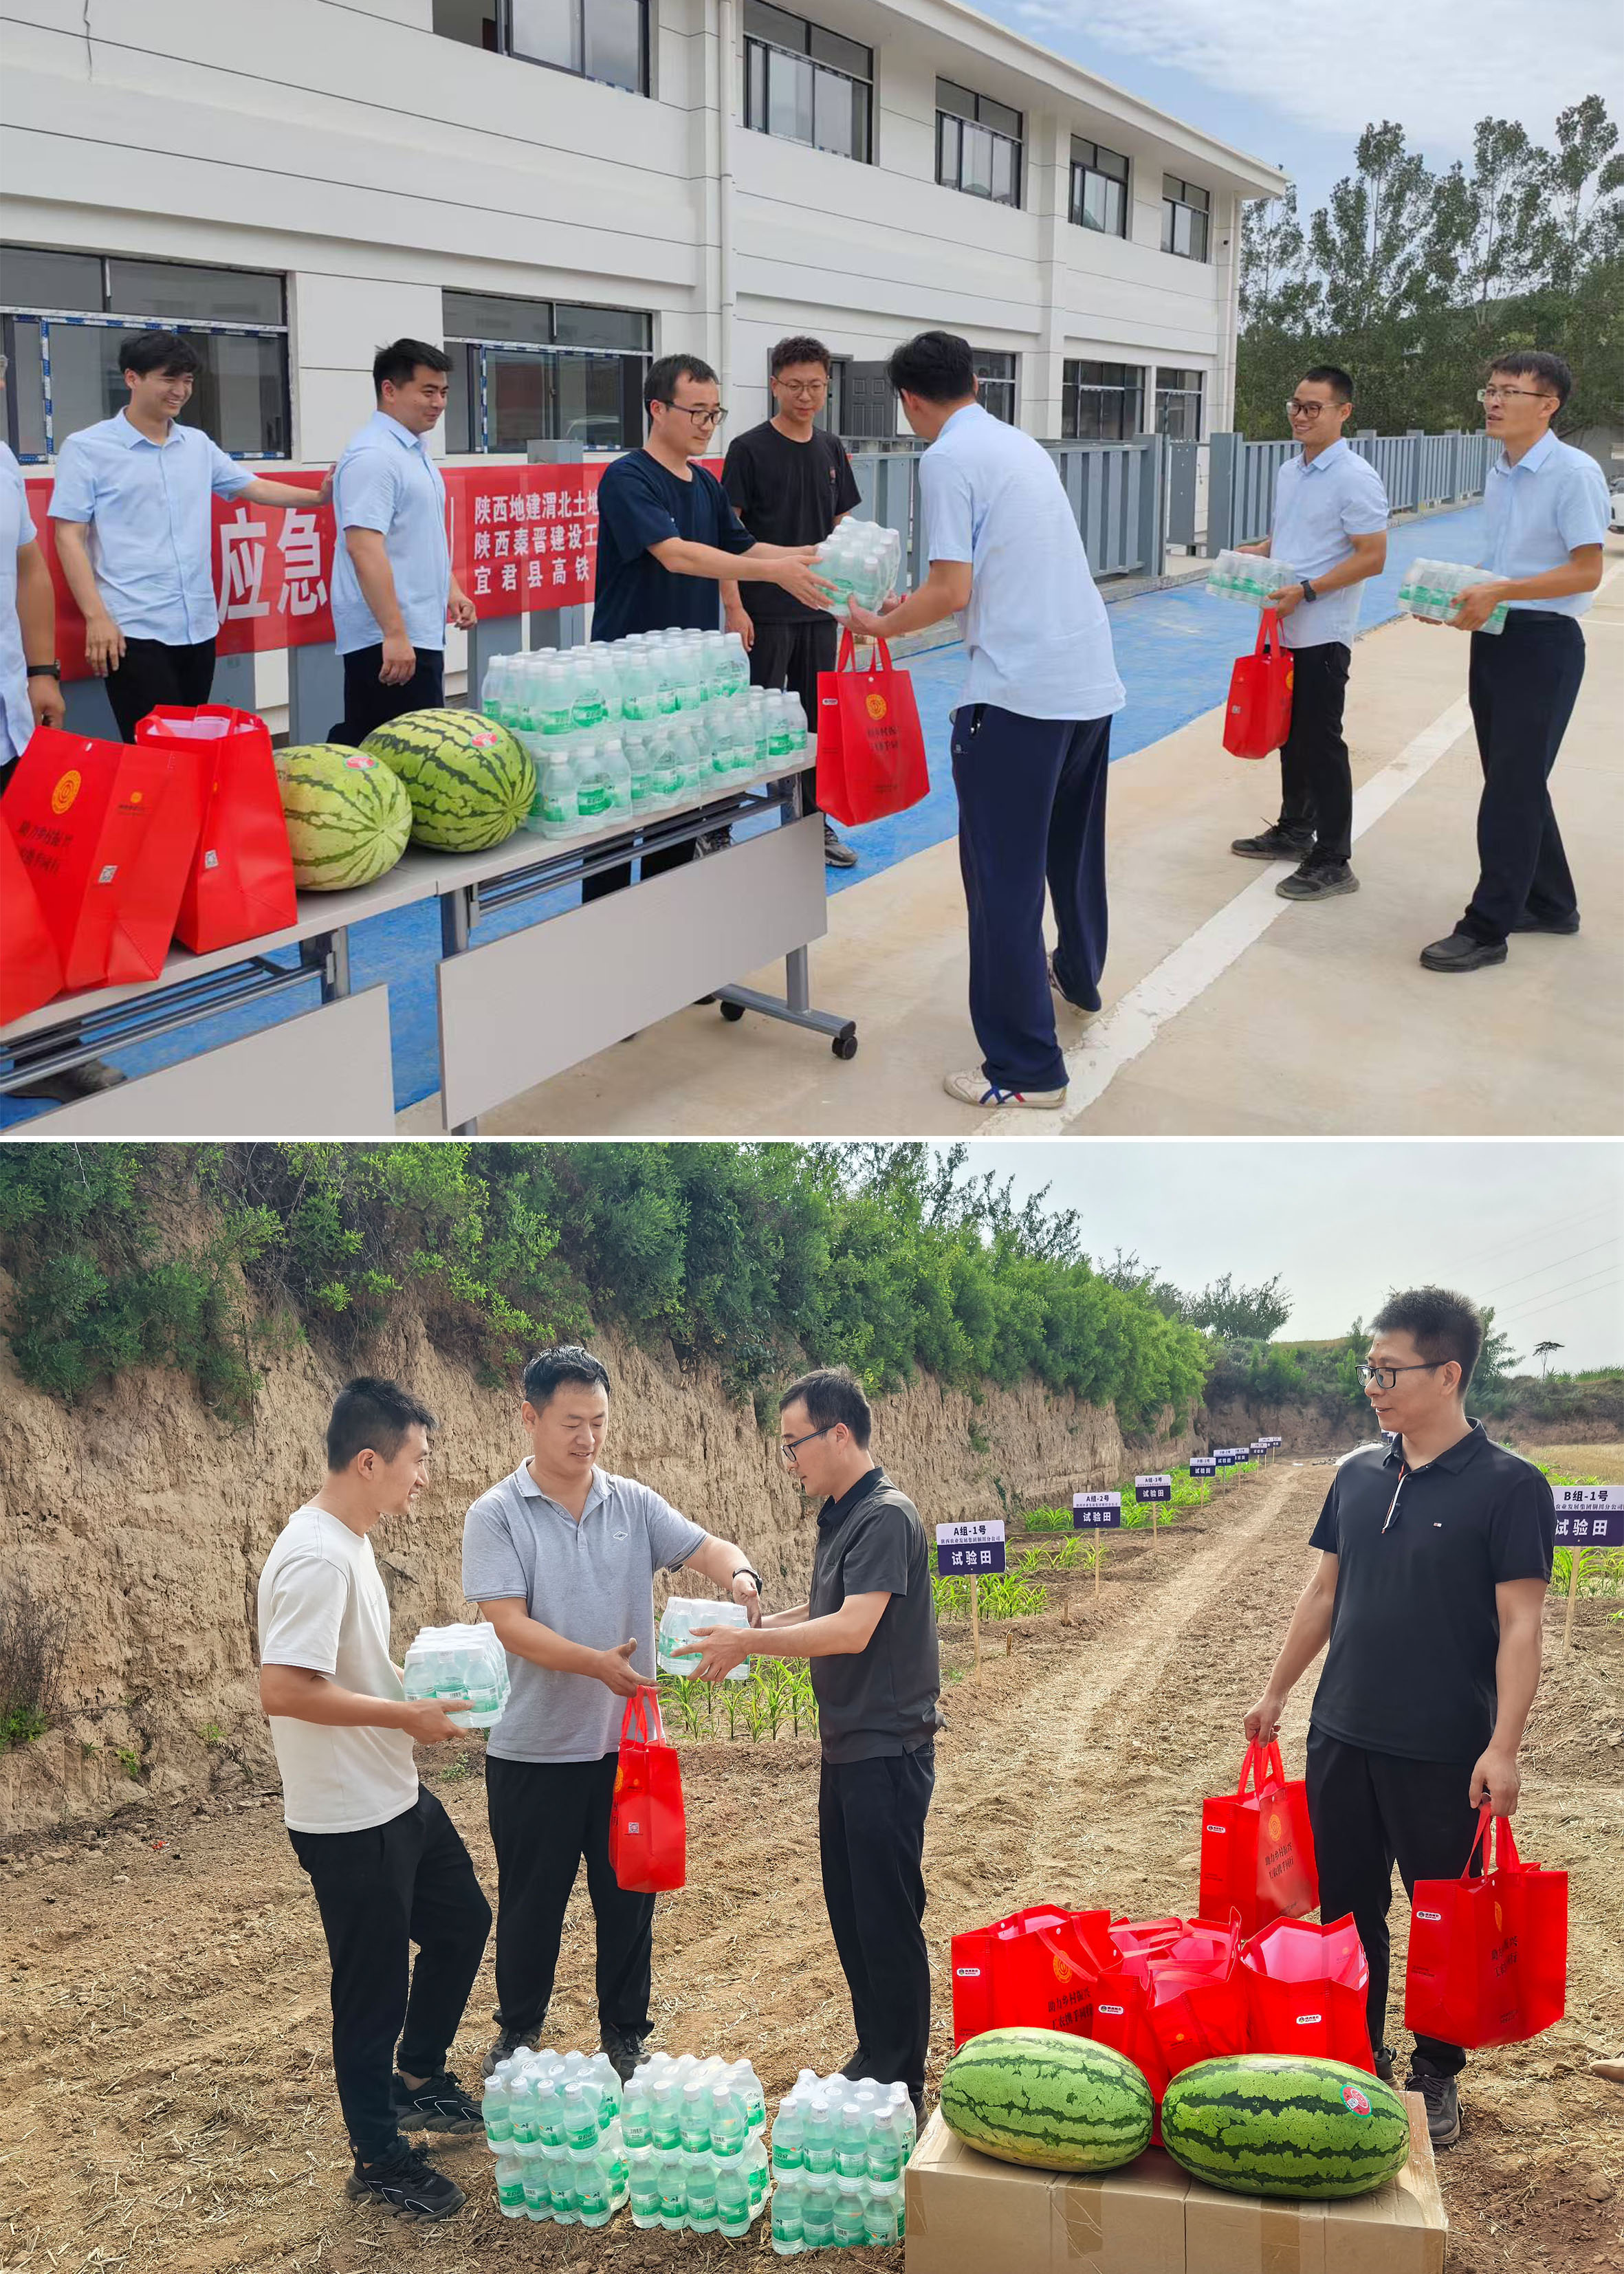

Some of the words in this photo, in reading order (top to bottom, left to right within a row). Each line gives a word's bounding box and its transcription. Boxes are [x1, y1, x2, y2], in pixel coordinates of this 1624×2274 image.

[474, 490, 599, 525] 陕西地建渭北土地
[474, 523, 597, 560] 陕西秦晋建设工
[217, 507, 327, 625] 应急
[474, 556, 589, 595] 宜君县高铁
[1143, 1489, 1164, 1498] 试验田
[1563, 1490, 1608, 1501] B组-1号
[1083, 1511, 1111, 1522] 试验田
[954, 1525, 986, 1535] A组-1号
[1555, 1518, 1607, 1536] 试验田
[952, 1551, 991, 1566] 试验田
